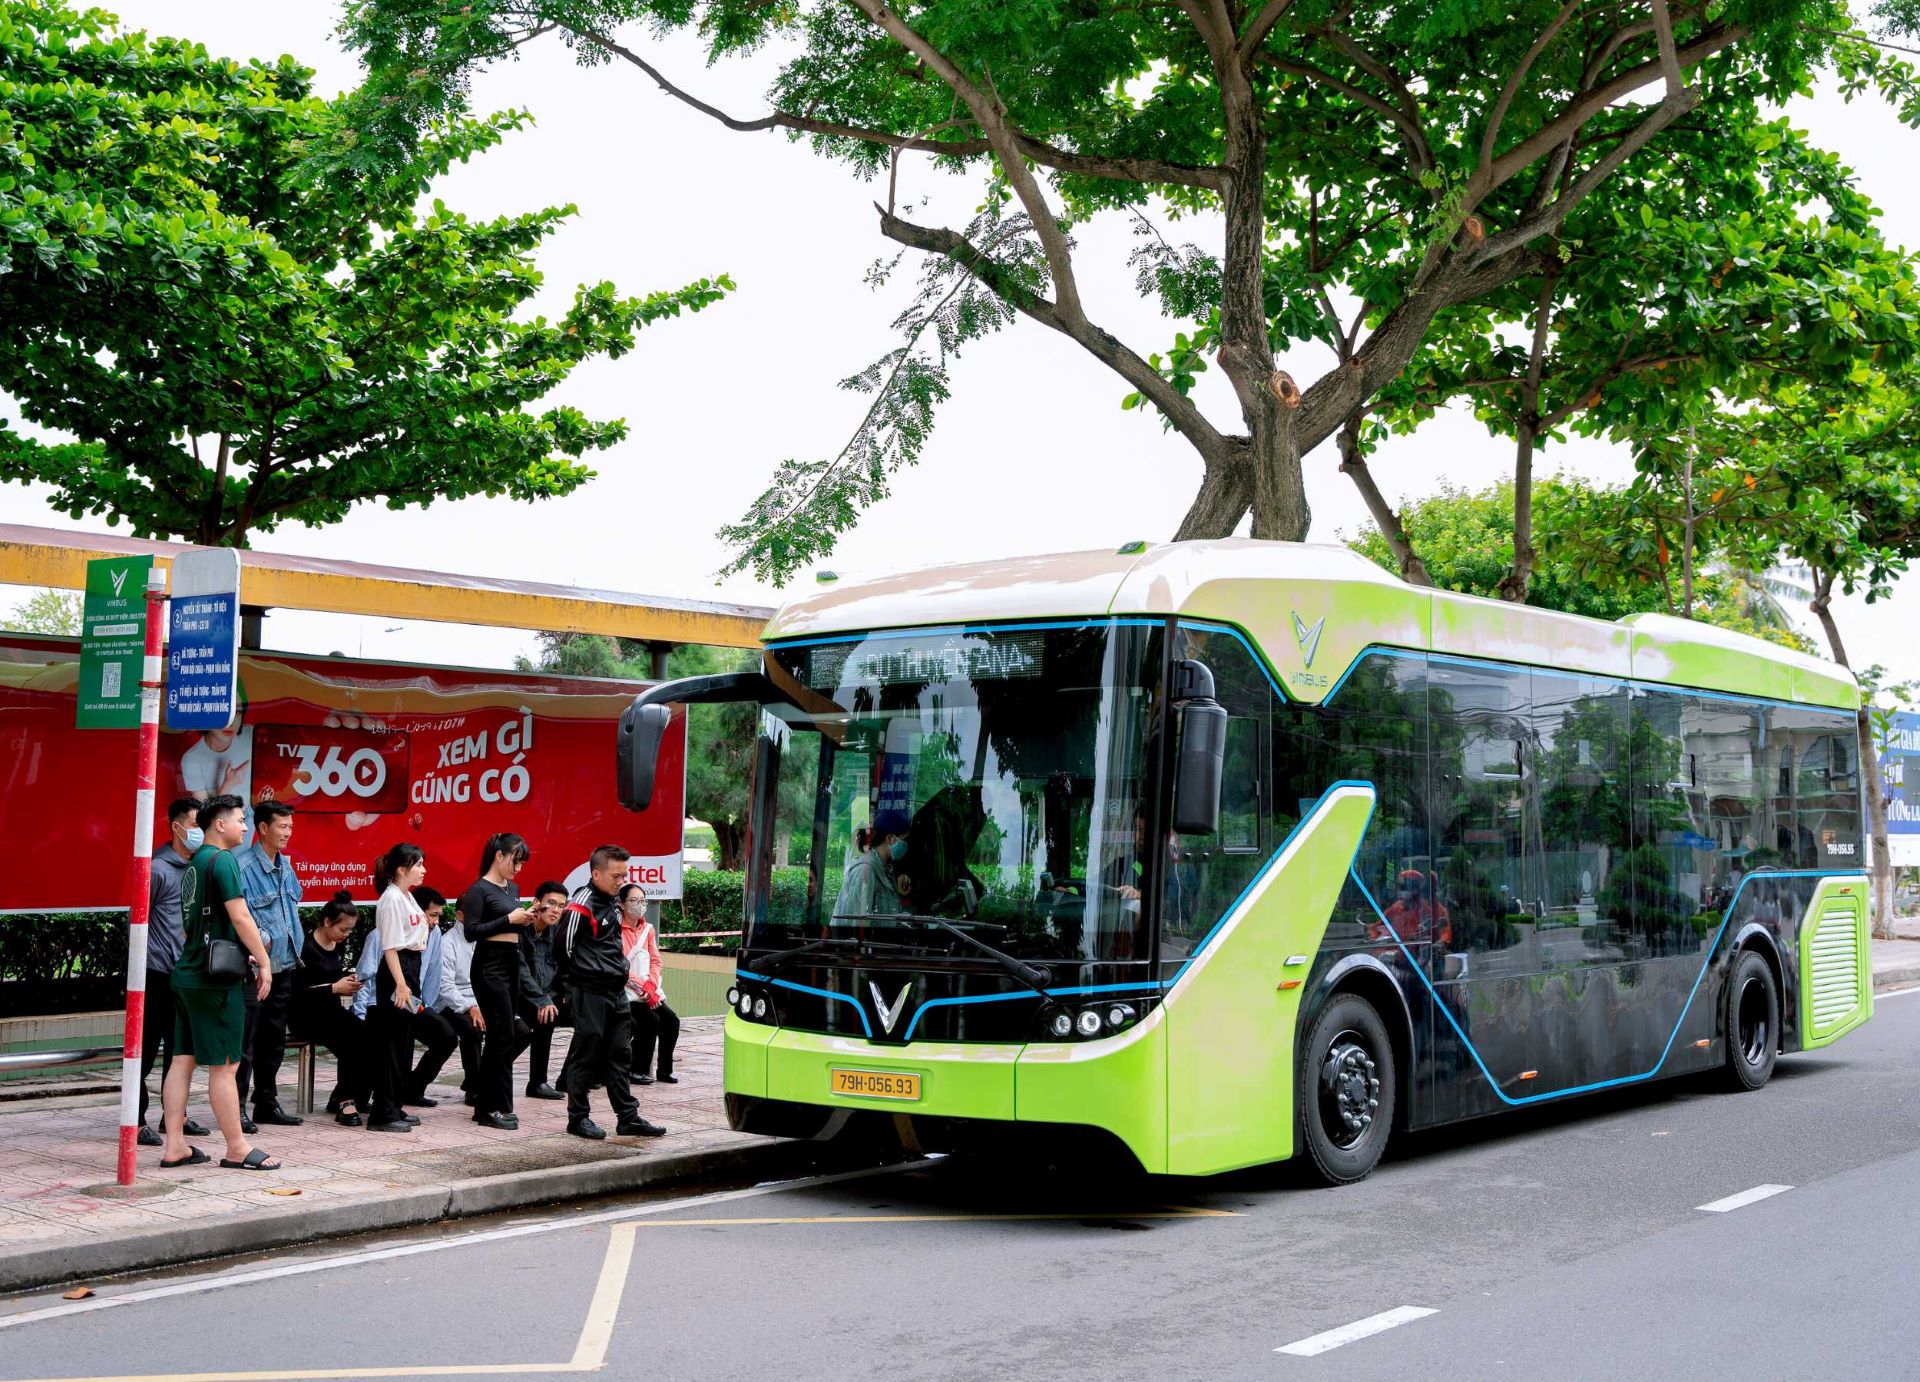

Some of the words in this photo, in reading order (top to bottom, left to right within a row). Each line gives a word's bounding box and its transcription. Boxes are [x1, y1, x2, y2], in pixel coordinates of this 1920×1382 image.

[436, 729, 488, 769] XEM
[495, 705, 533, 755] GÌ
[411, 772, 471, 804] CŨNG
[478, 753, 531, 803] CÓ
[295, 862, 308, 871] Tải
[309, 863, 329, 873] ngay
[330, 862, 346, 873] ứng
[346, 862, 367, 873] dụng
[322, 876, 340, 886] hình
[341, 876, 356, 888] giải
[357, 877, 367, 885] trí
[839, 1074, 913, 1095] 79H-056.93
